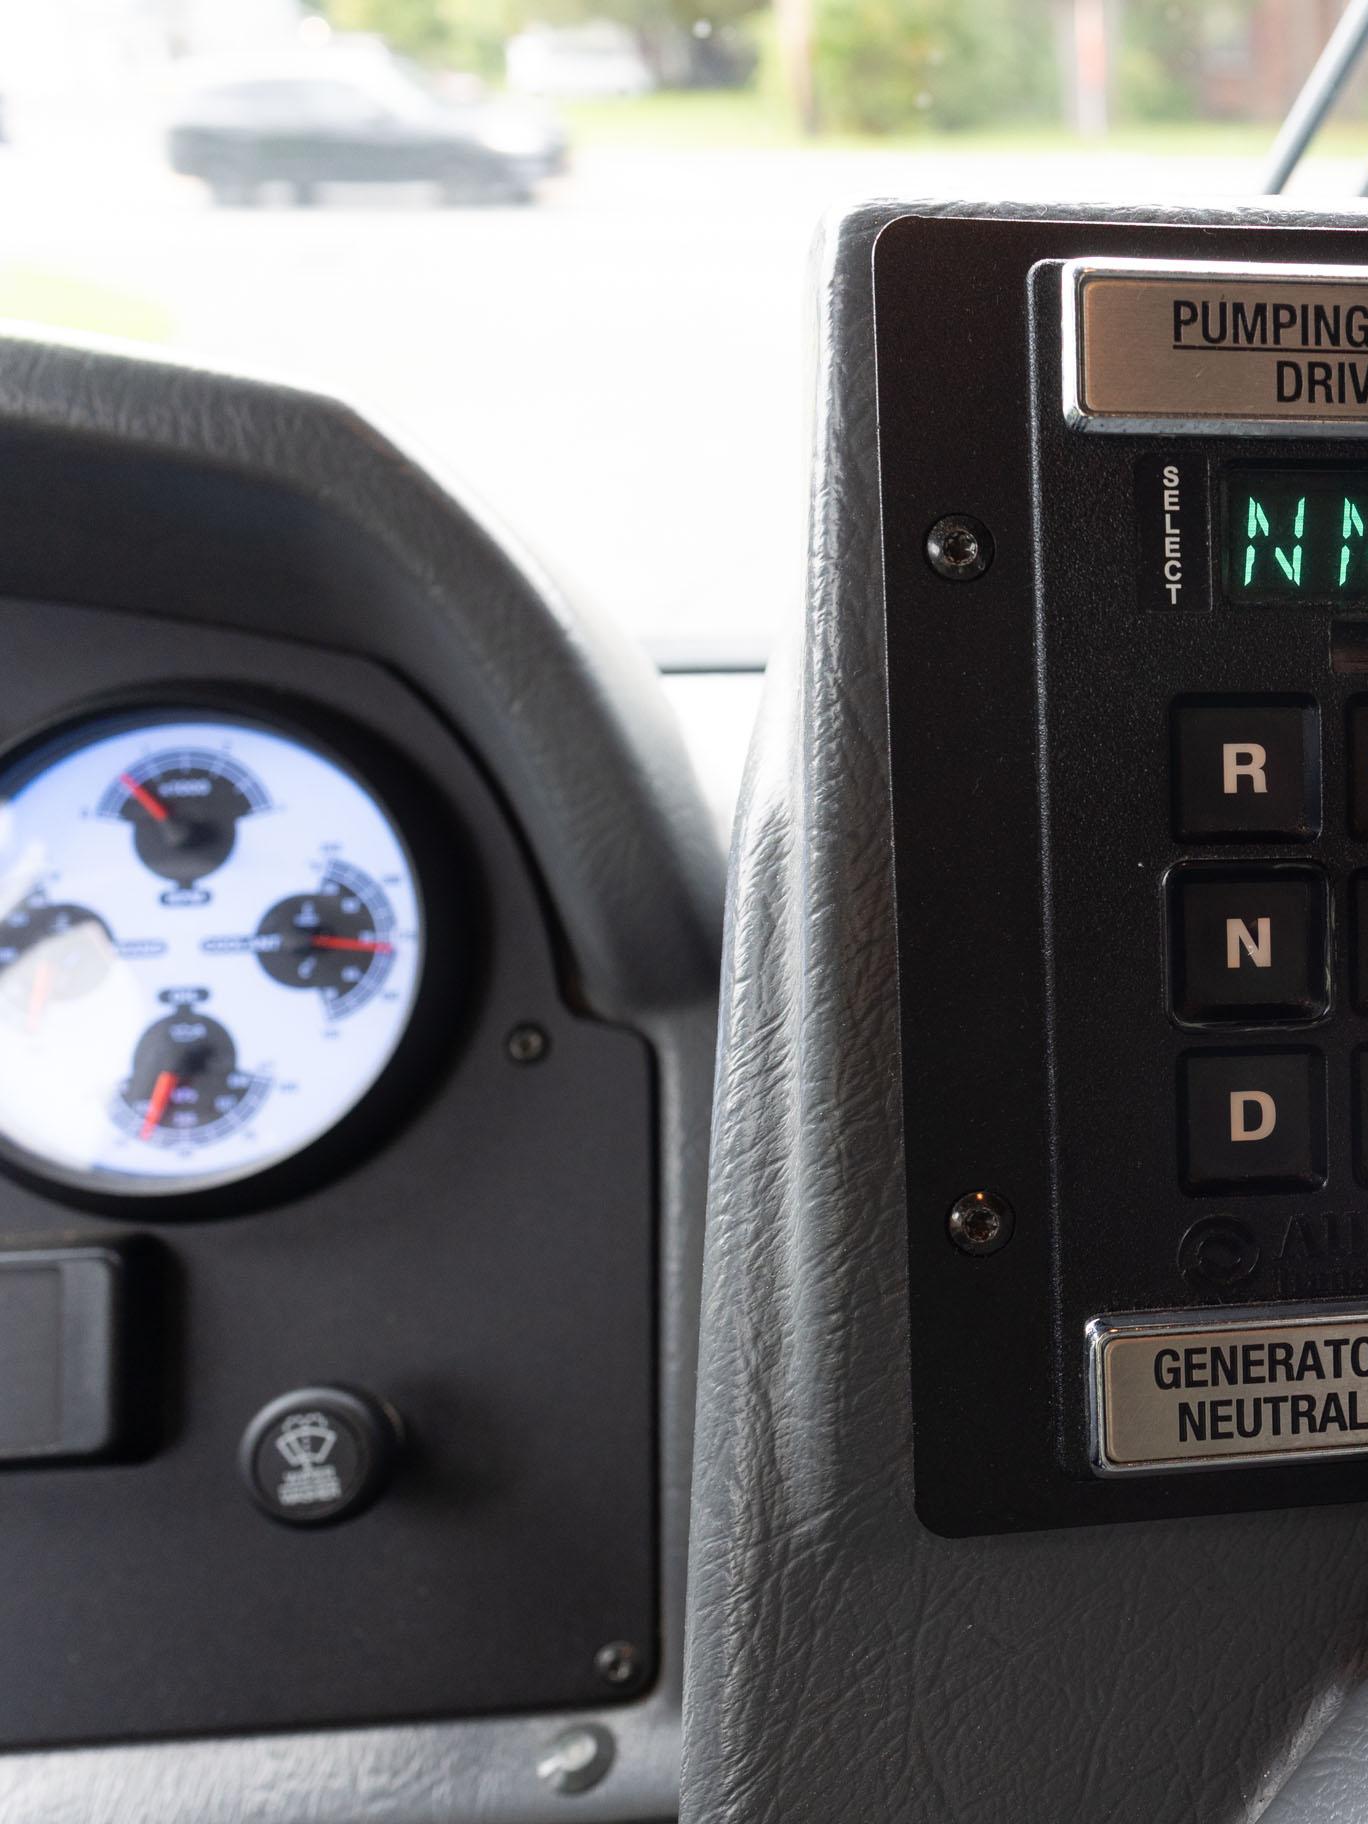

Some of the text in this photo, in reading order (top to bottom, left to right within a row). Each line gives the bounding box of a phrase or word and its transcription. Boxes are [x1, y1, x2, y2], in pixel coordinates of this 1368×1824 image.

[1162, 465, 1183, 605] SELECT
[1222, 743, 1268, 794] R
[1225, 917, 1272, 968] N
[1230, 1090, 1277, 1142] D
